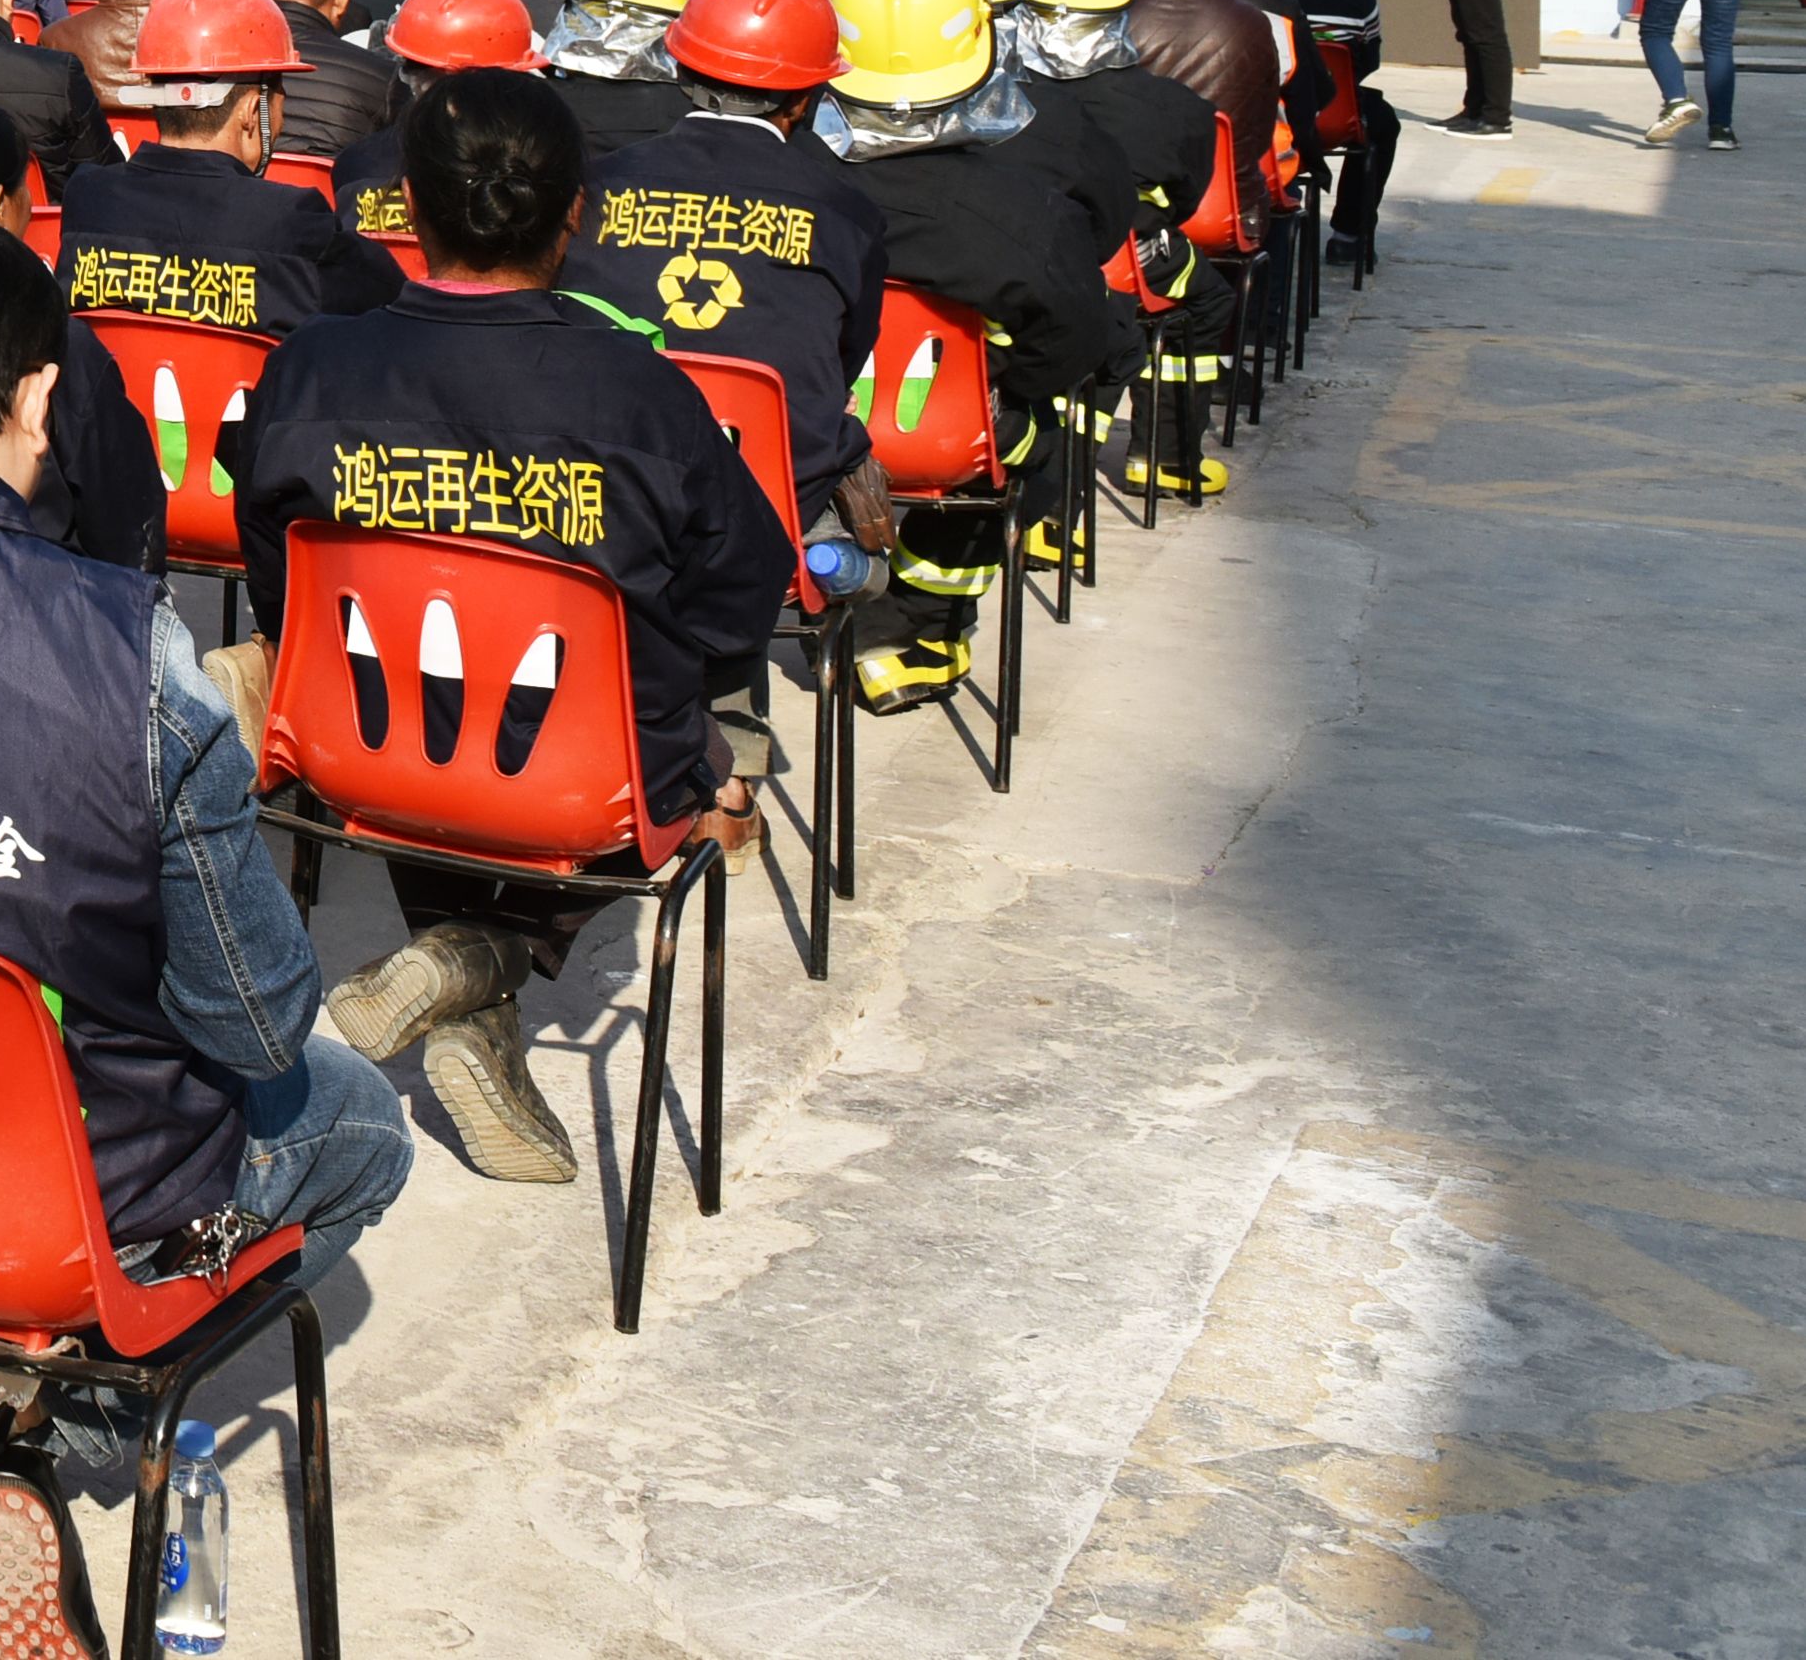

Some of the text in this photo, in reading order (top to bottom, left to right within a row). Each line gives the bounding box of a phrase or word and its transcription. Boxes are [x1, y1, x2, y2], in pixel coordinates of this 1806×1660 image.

[597, 185, 815, 268] 鸿运再生资源
[71, 245, 258, 328] 鸿运再生资源
[332, 441, 605, 548] 鸿运再生资源
